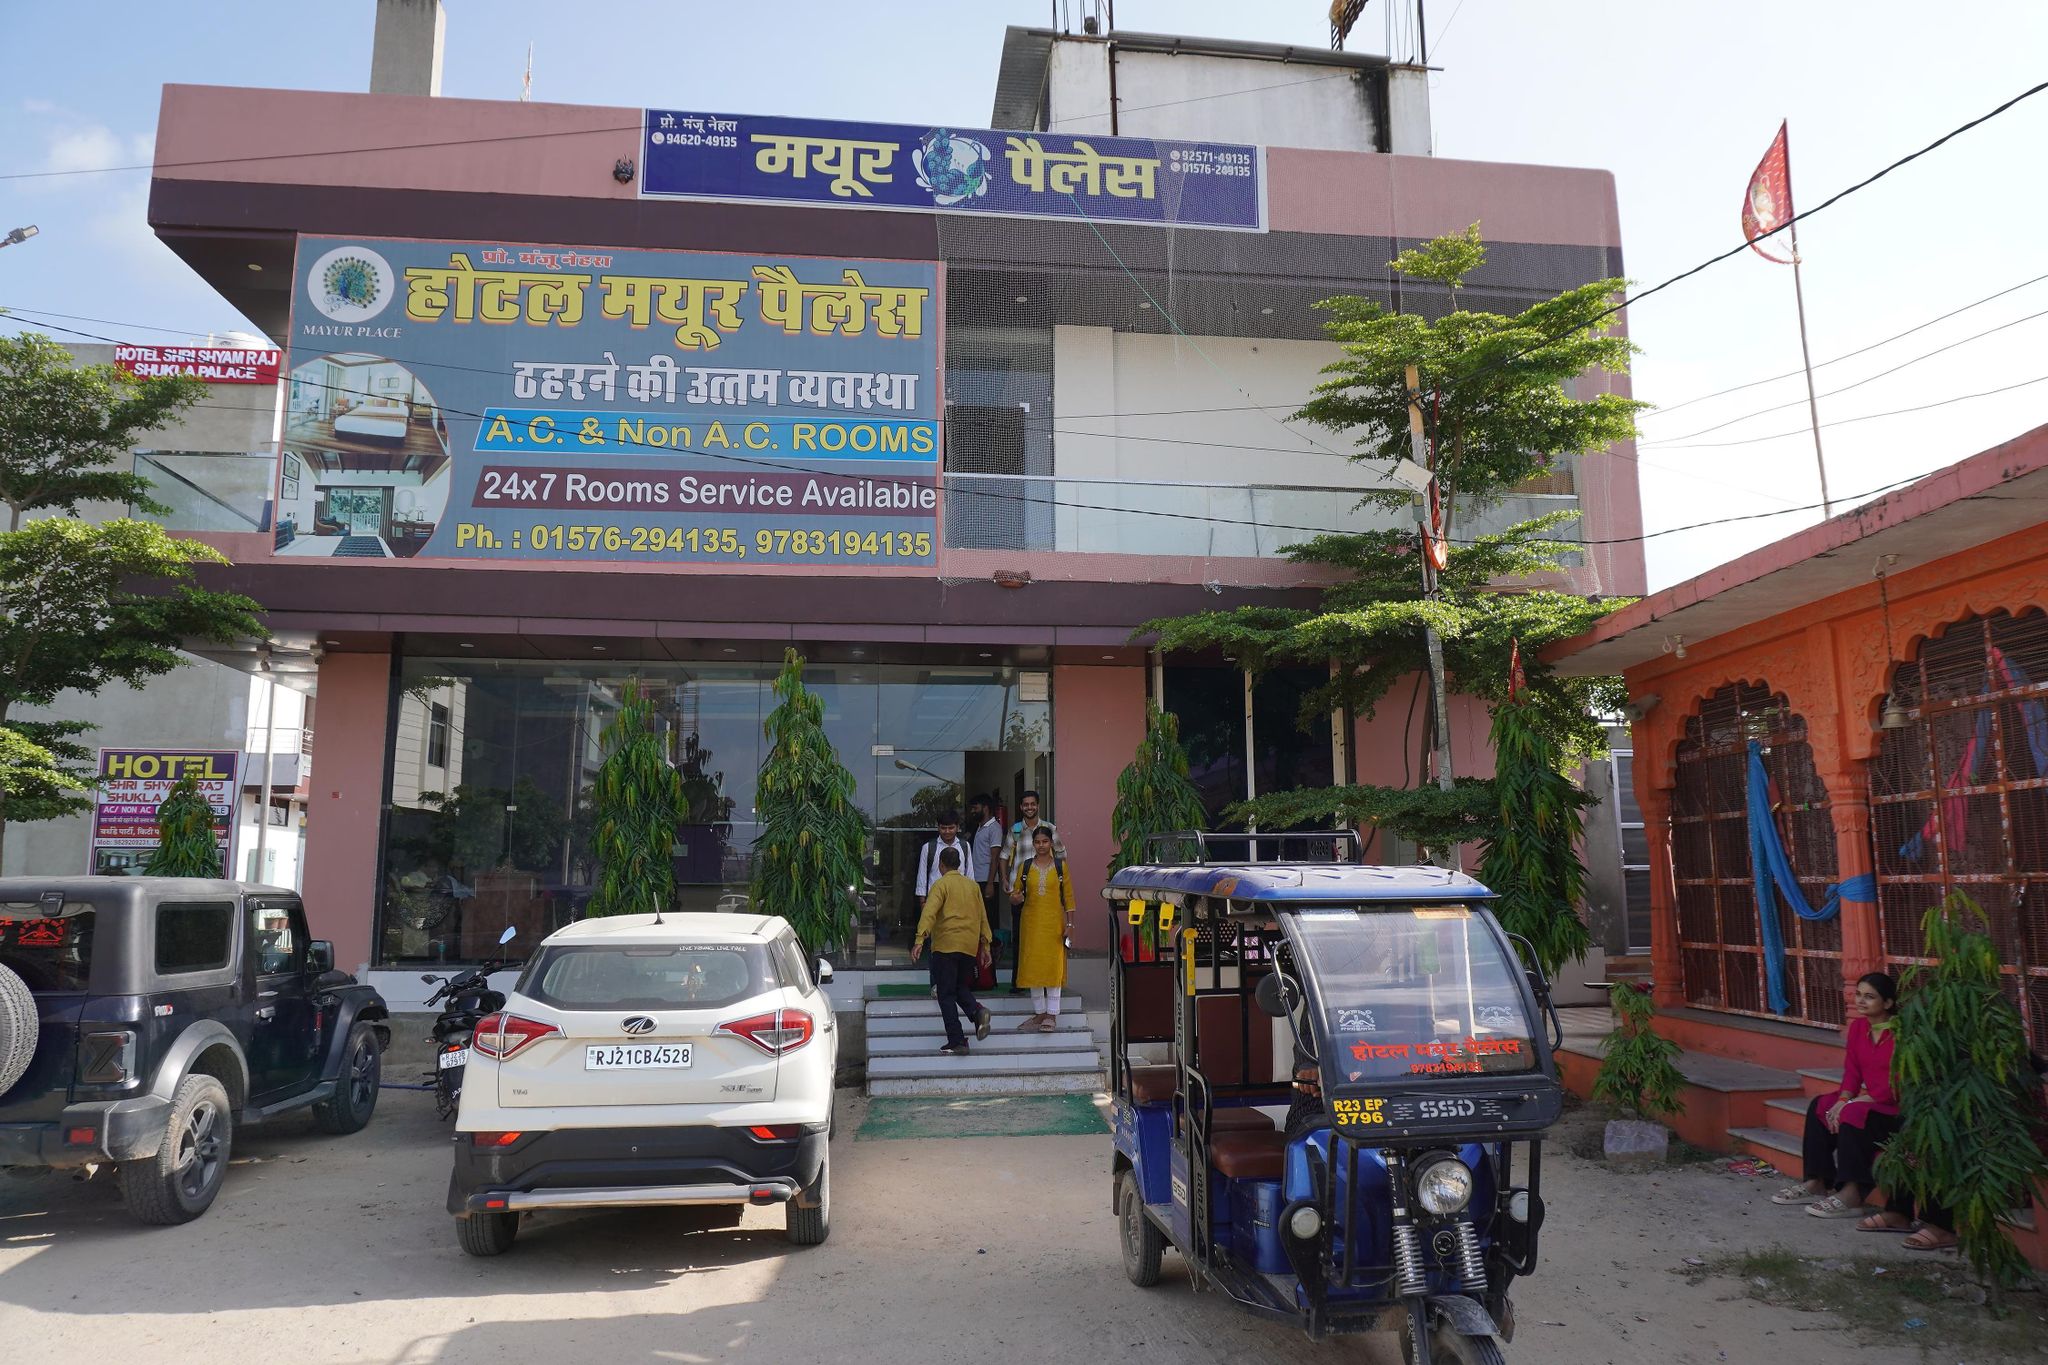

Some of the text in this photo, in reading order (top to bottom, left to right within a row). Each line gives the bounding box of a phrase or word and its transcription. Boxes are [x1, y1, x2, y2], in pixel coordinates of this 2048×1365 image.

[708, 116, 738, 132] नेहरा
[666, 133, 737, 148] 94620-49135
[751, 134, 1161, 199] मयूर पैलेस
[404, 252, 929, 350] होटल मयूर पैलेस
[303, 325, 402, 338] MAYUR PLACE
[115, 347, 277, 366] HOTEL SHRI SHYAM RAJ
[198, 365, 257, 379] PALACE
[512, 351, 919, 410] ठहरने की उत्तम व्यवस्था
[485, 414, 934, 453] A.C. & Non A.C. ROOMS
[483, 471, 937, 509] 24x7 Rooms Service Available
[456, 522, 502, 549] Ph.
[530, 524, 747, 559] 01576-294135,
[755, 528, 932, 557] 9783194135
[108, 754, 228, 779] HOTEL
[109, 781, 137, 790] SHRI
[107, 793, 162, 803] SHUKLA
[121, 806, 138, 814] NON
[140, 806, 152, 814] AC
[596, 1047, 690, 1066] RJ21CB4528
[1351, 1036, 1522, 1064] होटल मयूर पैलेस
[1333, 1100, 1384, 1112] R23 EP
[1419, 1100, 1475, 1118] SSD
[1336, 1112, 1384, 1125] 3796
